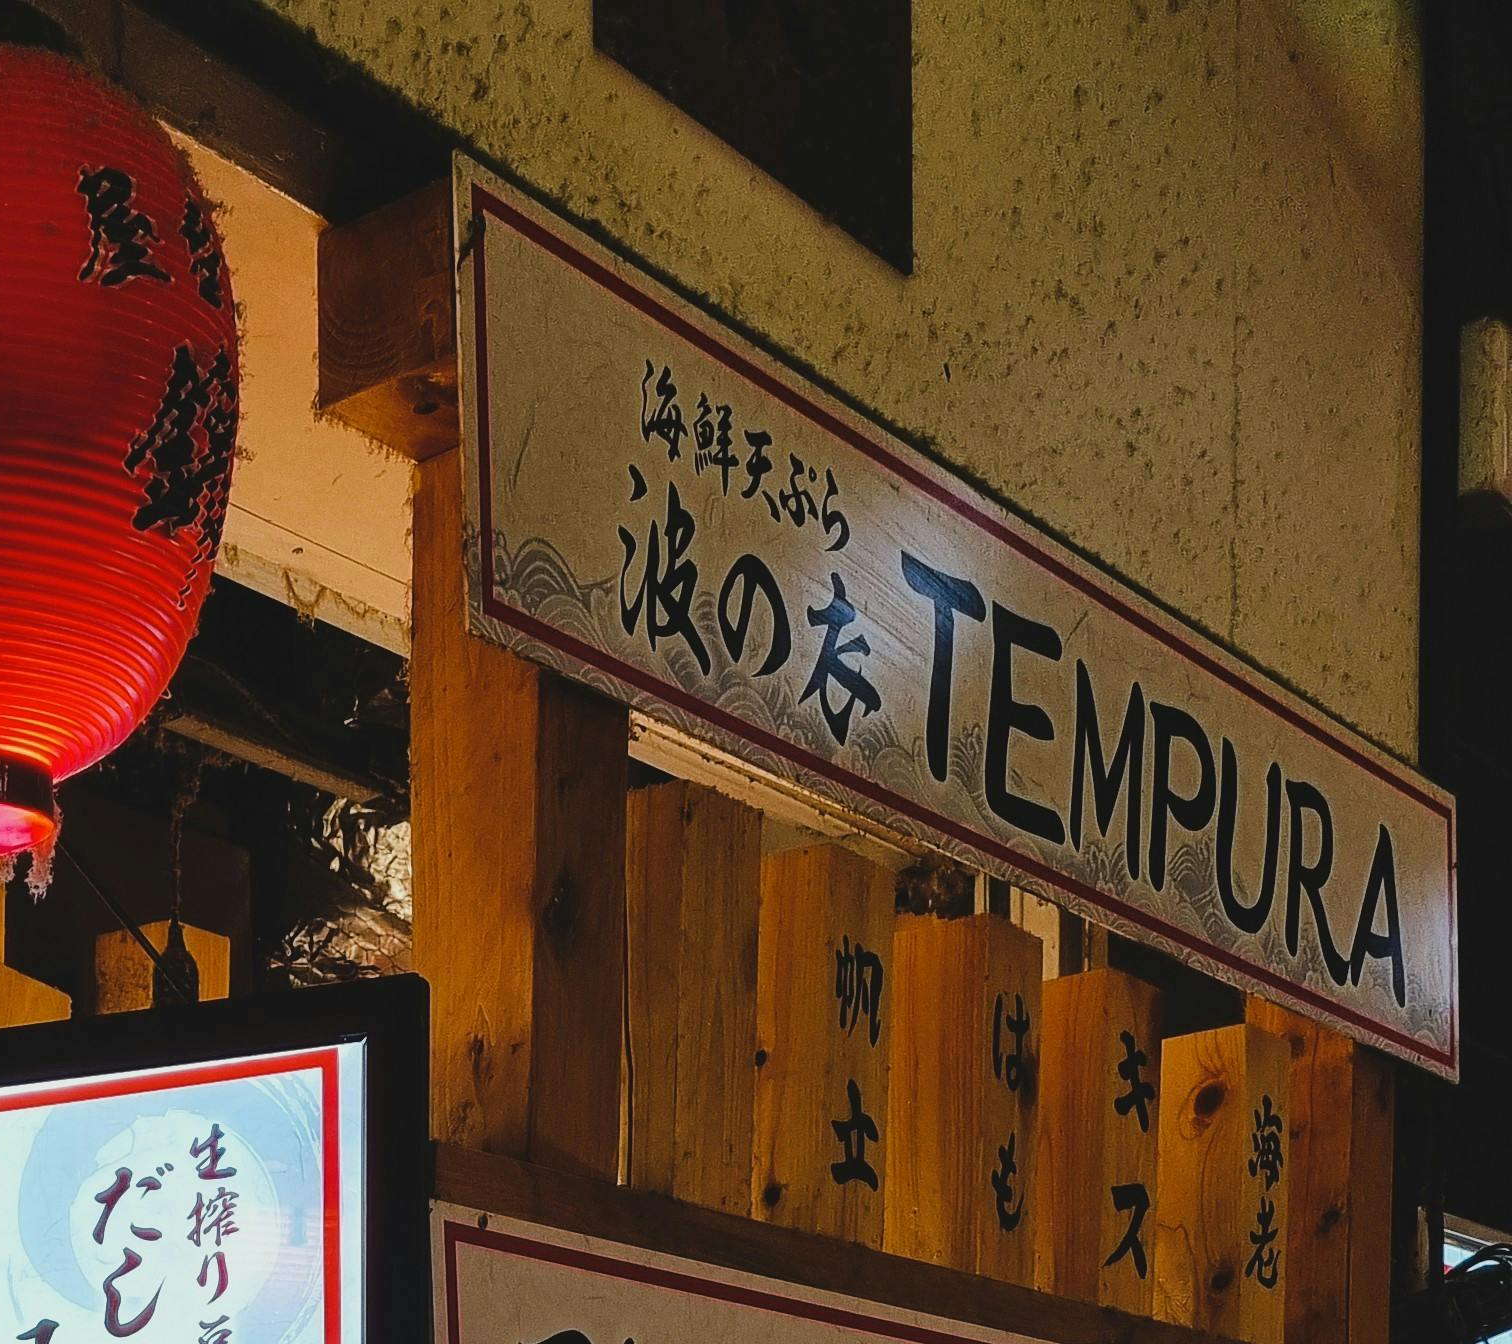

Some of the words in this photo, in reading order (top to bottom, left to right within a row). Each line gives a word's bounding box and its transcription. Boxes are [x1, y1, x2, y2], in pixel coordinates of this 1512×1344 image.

[639, 358, 850, 552] 海鮮天ぷら
[618, 465, 882, 747] 波の衣
[901, 548, 1408, 1008] TEMPURA
[830, 932, 883, 1191] 帆立
[991, 992, 1031, 1233] はも
[1109, 1030, 1156, 1280] キス
[1245, 1094, 1285, 1291] 海老
